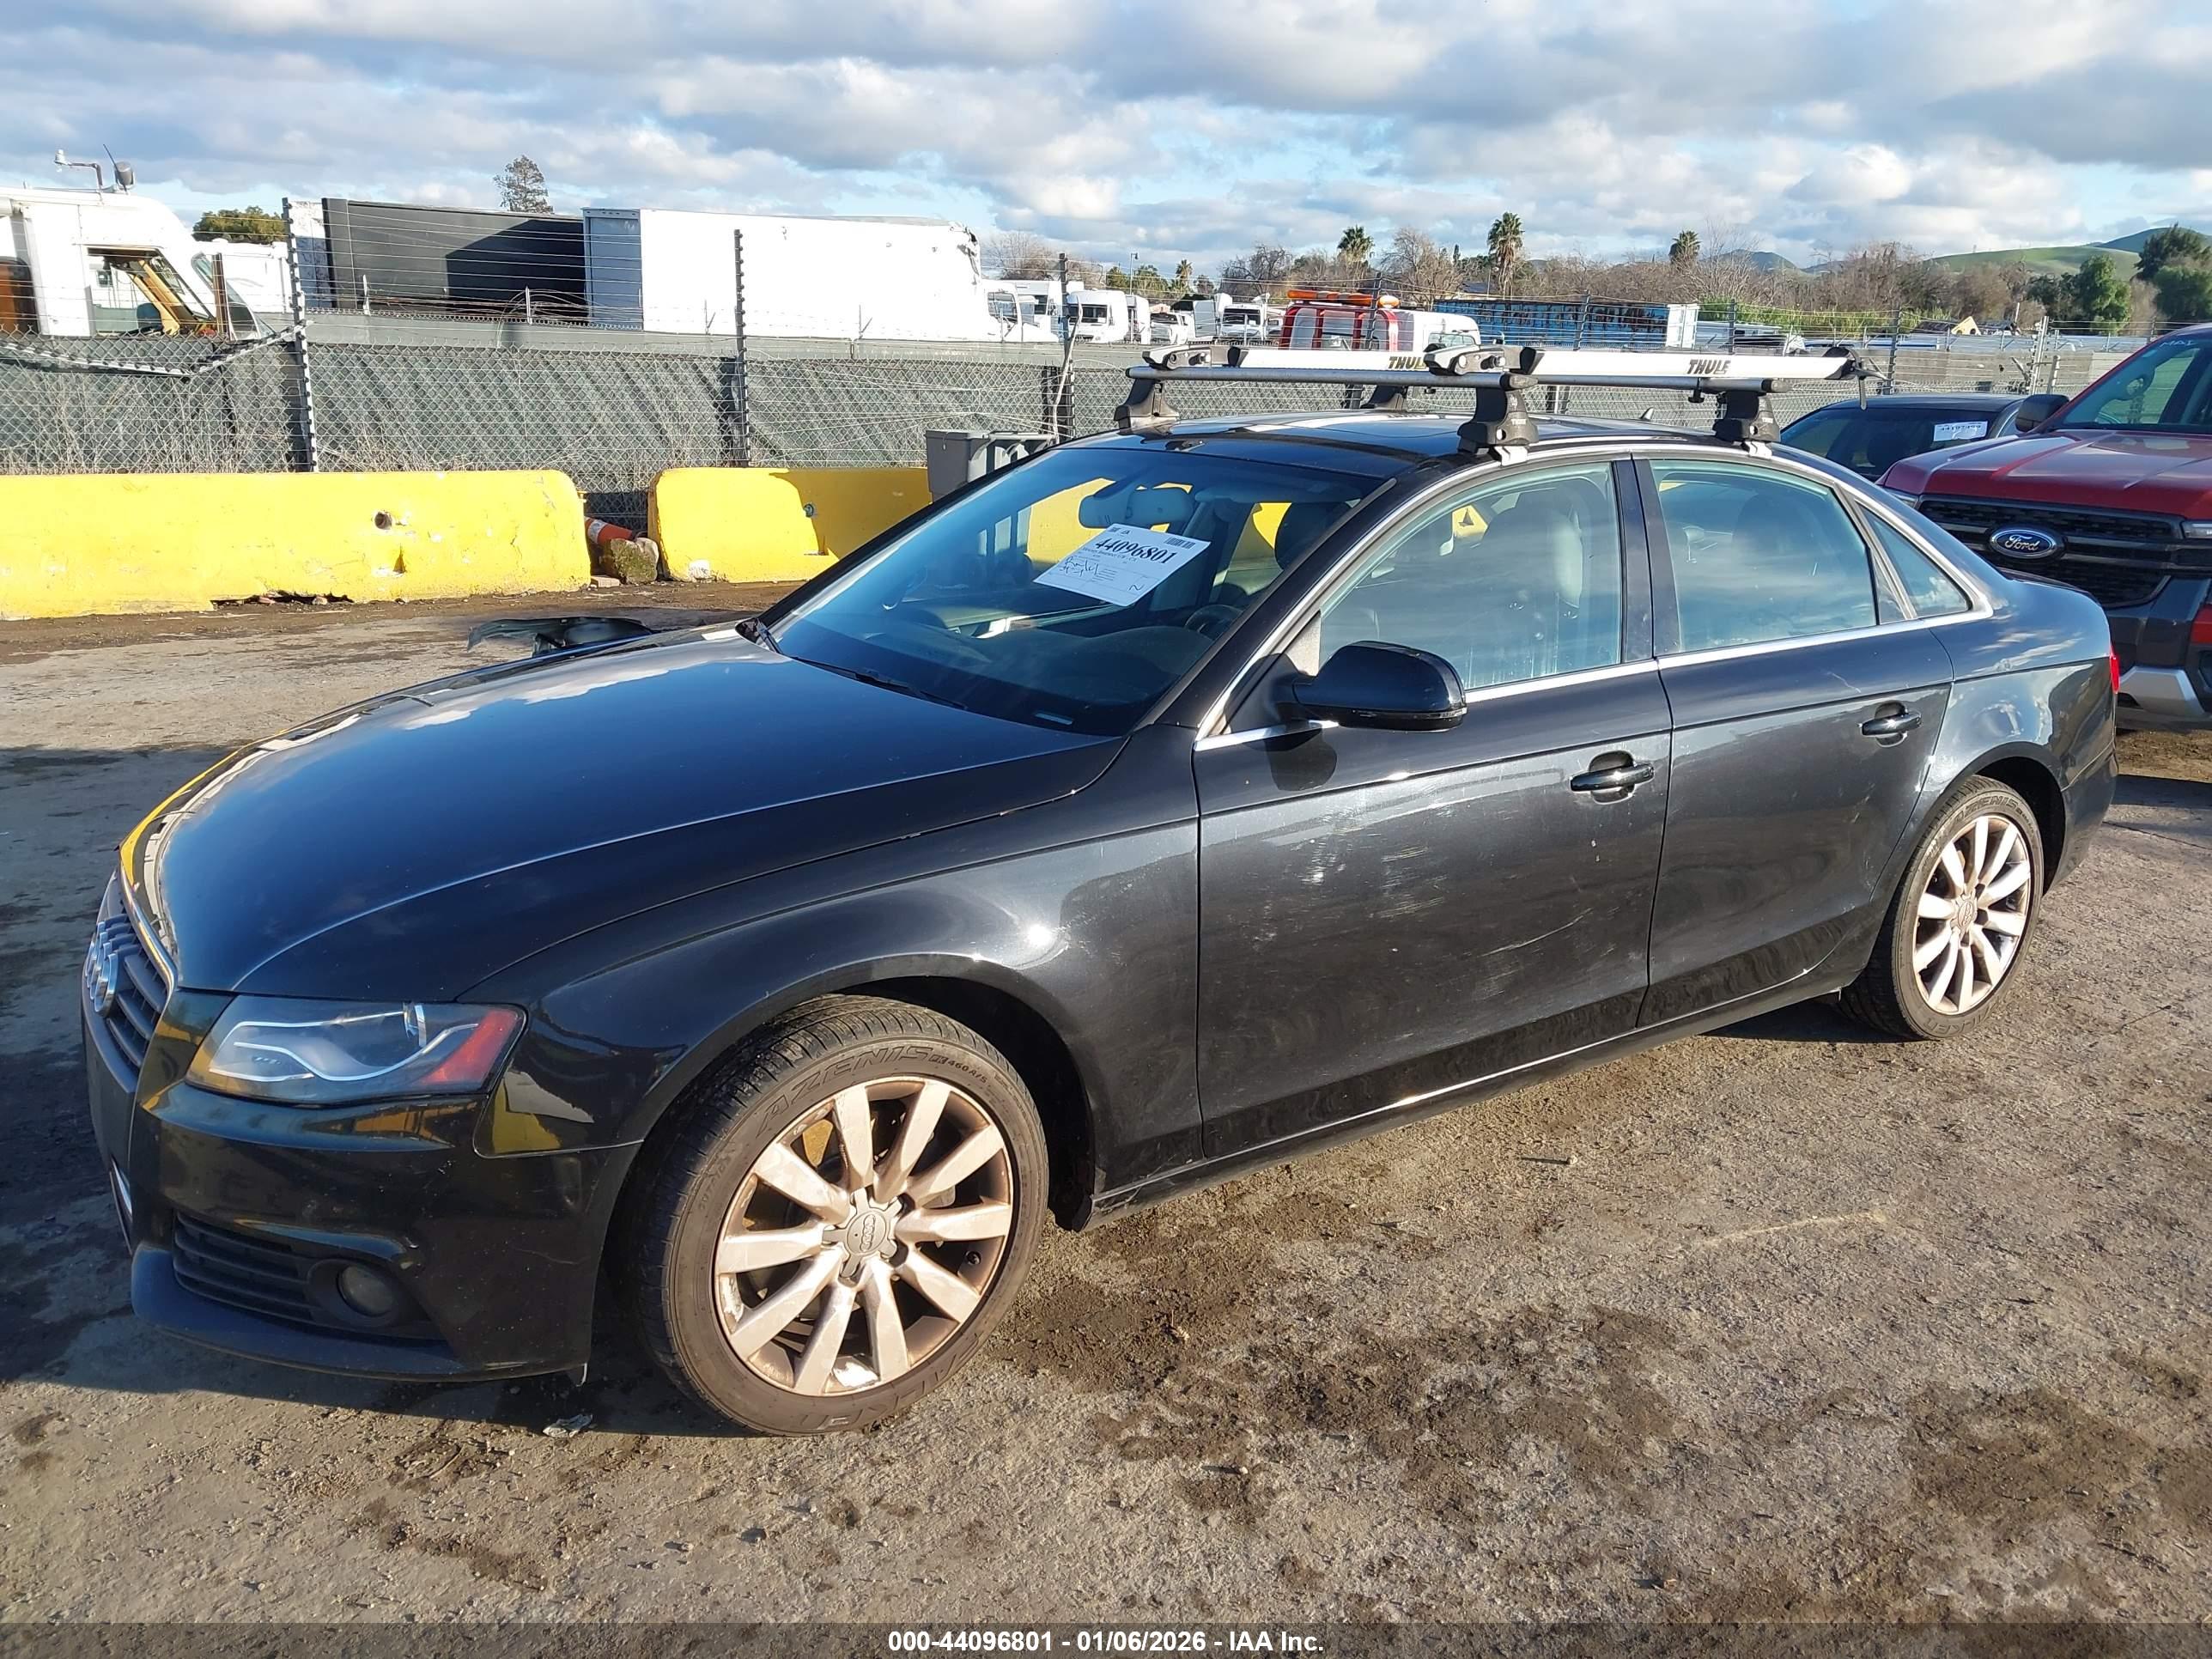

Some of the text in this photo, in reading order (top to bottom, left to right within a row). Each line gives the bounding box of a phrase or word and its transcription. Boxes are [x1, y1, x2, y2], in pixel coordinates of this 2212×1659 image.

[1686, 358, 1732, 375] THULE
[1095, 538, 1178, 565] 44096801
[2004, 534, 2040, 551] Ford
[1948, 795, 2020, 833] AZENIS
[756, 1045, 934, 1139] AZENIS
